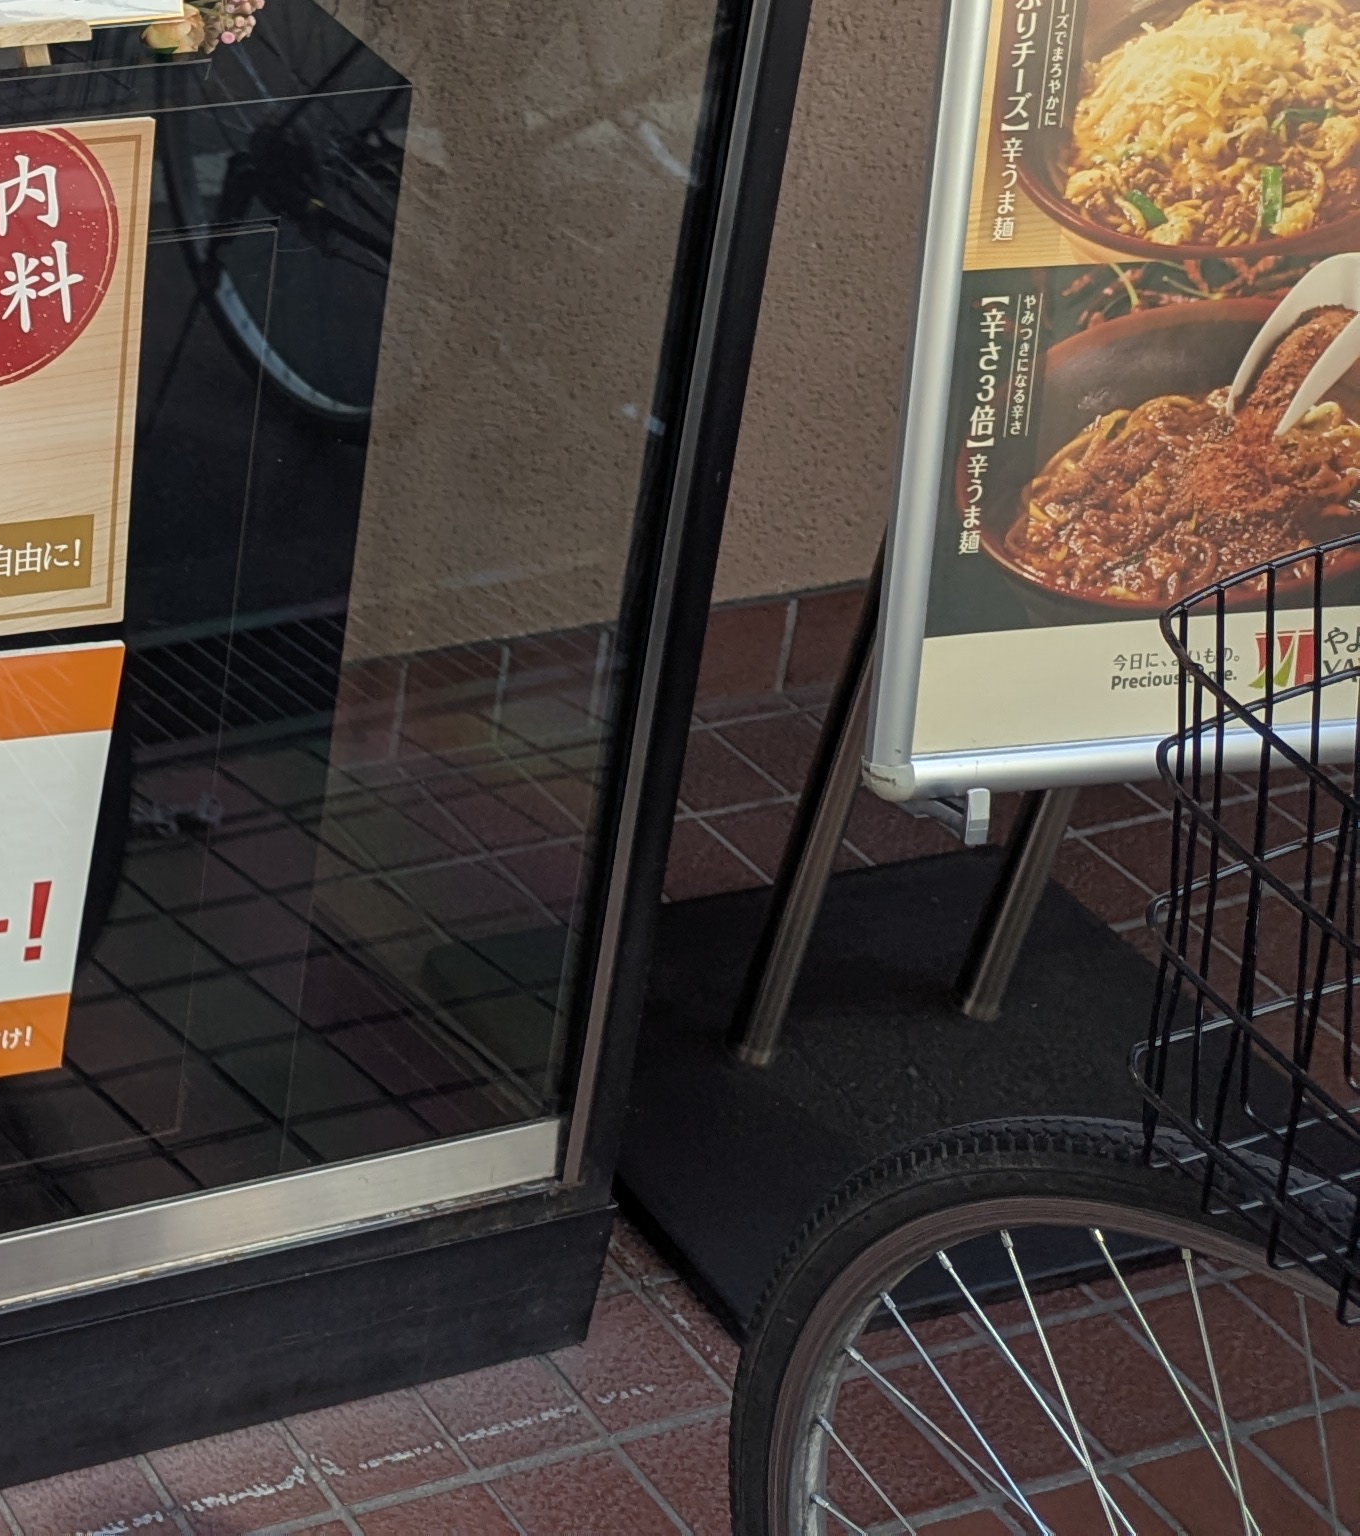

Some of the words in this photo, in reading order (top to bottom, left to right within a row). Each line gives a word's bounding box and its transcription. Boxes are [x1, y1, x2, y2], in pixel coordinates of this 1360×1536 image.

[958, 297, 1010, 555] 【辛さ3倍】辛うま麺
[1010, 294, 1037, 436] やみつきになる辛さ
[1111, 674, 1180, 690] Precious
